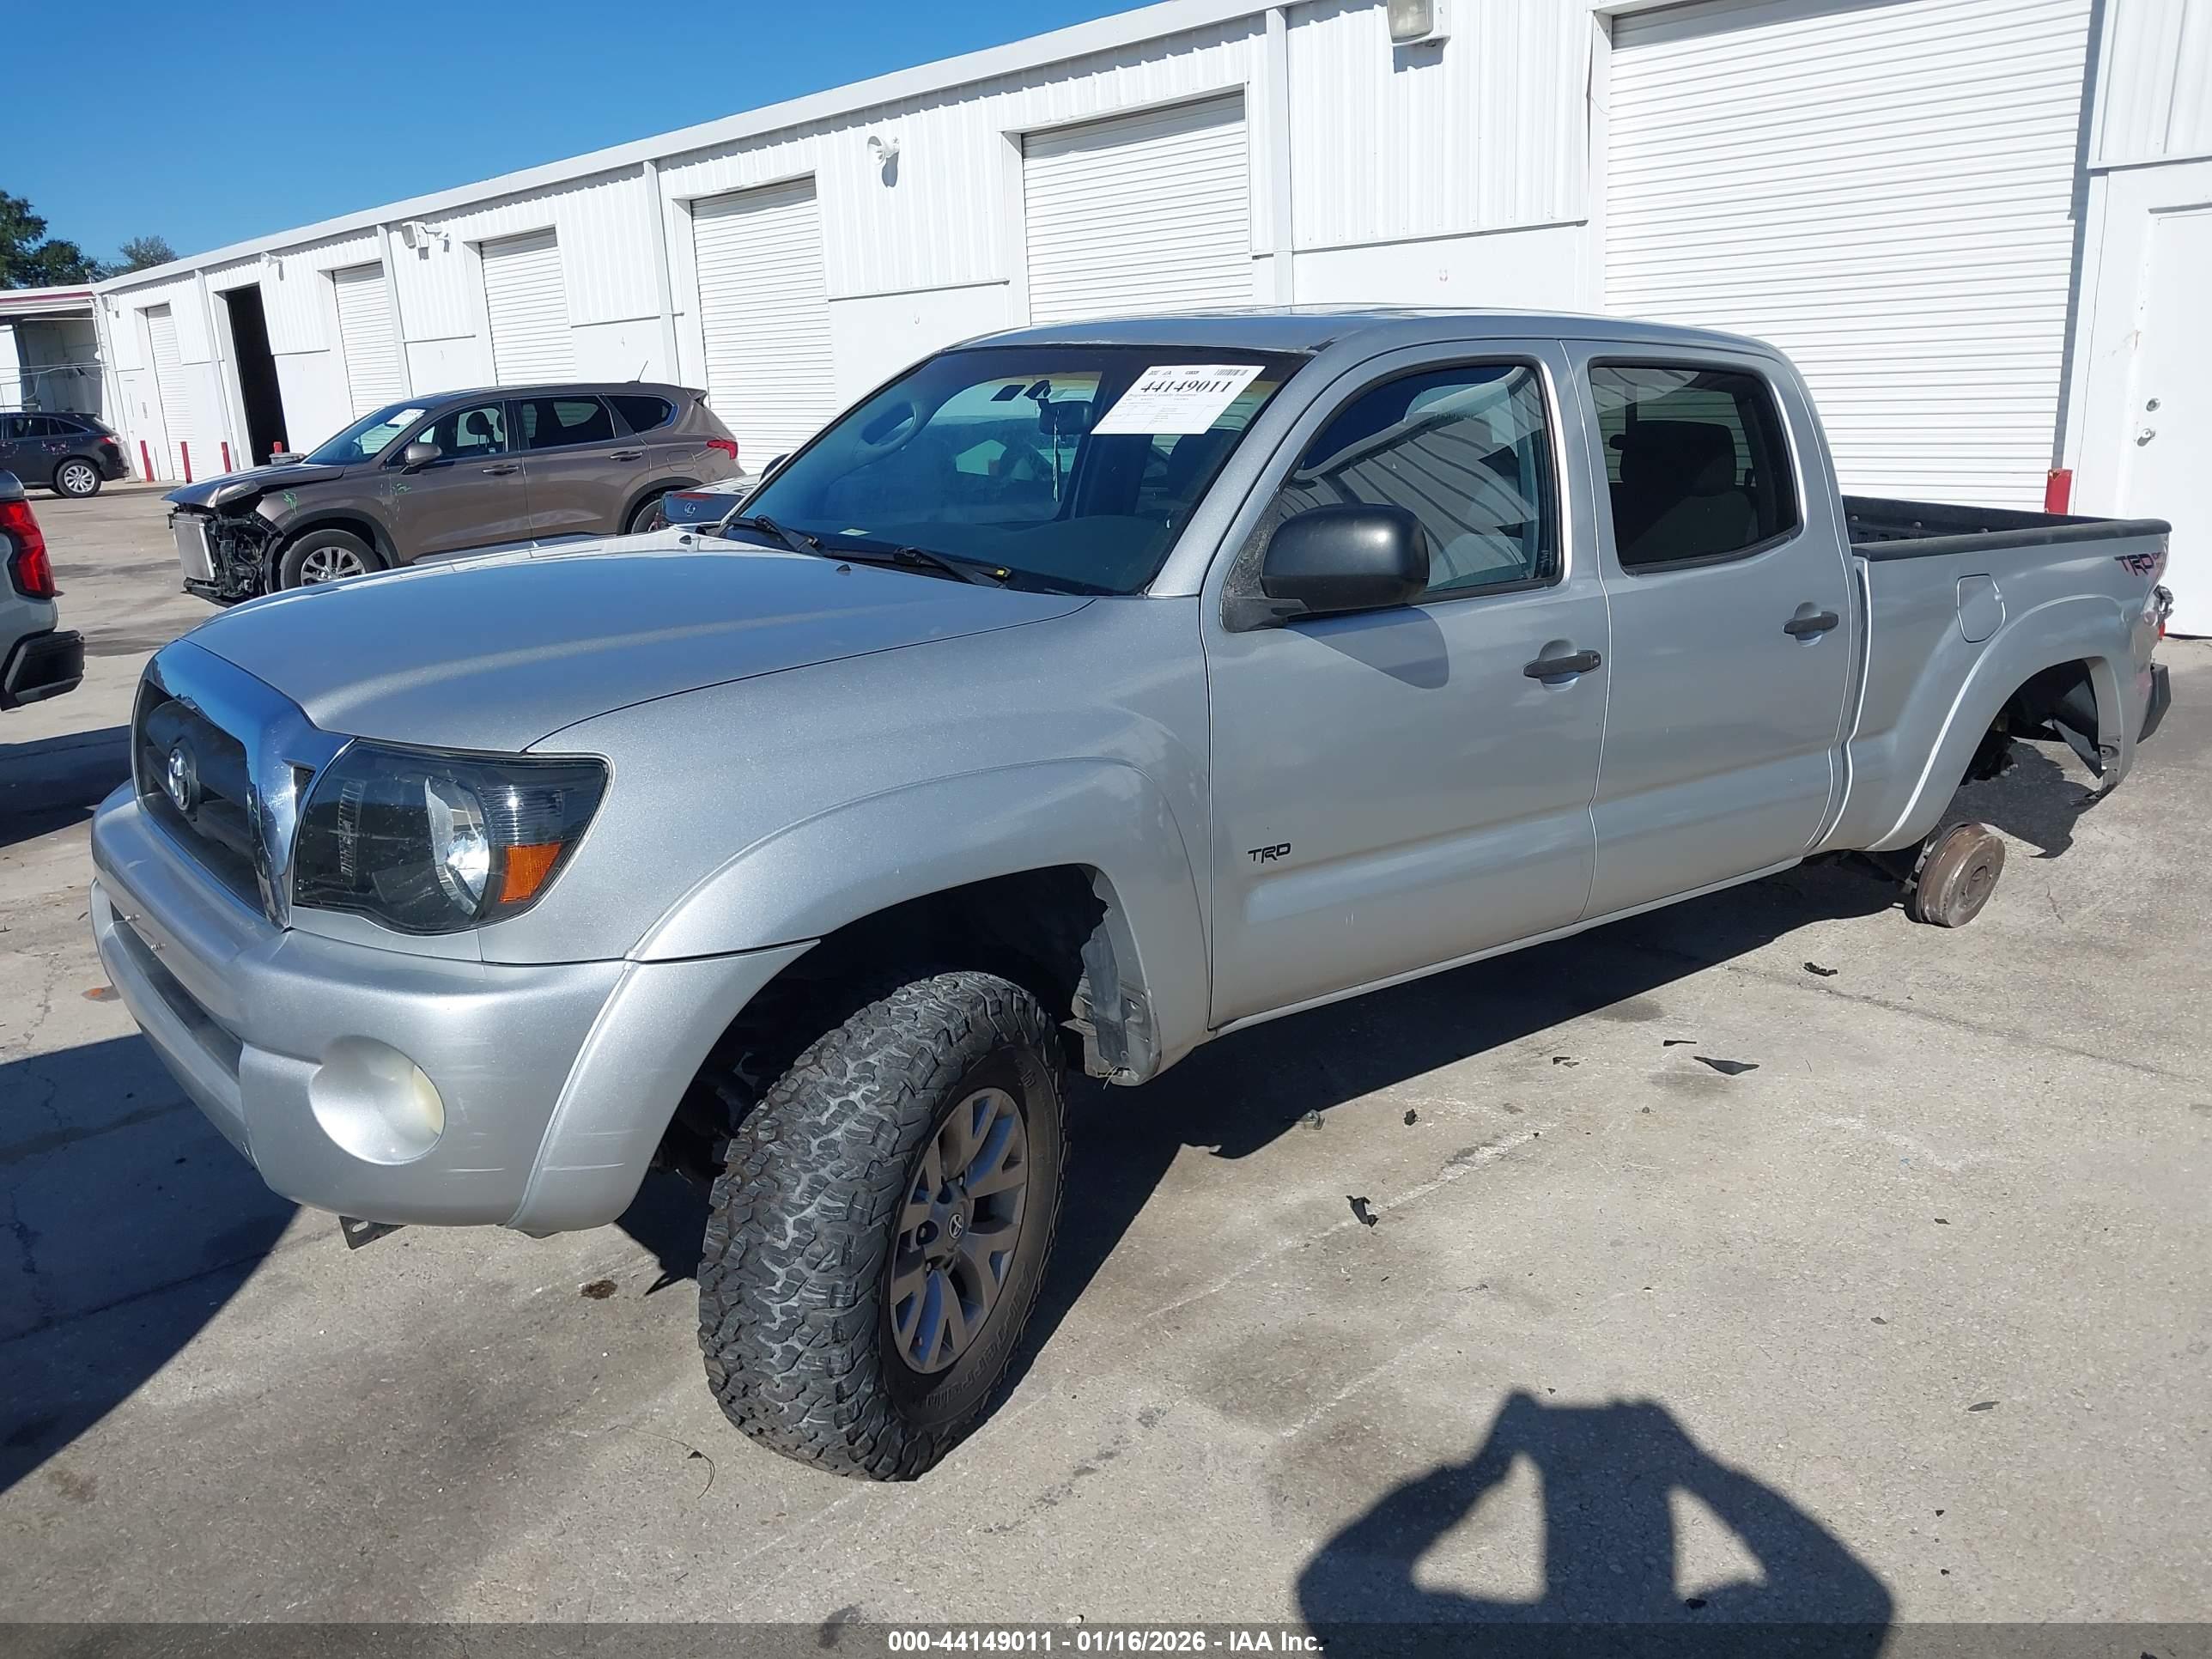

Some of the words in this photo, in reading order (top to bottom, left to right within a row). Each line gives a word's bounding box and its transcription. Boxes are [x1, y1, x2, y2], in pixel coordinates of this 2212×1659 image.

[1140, 380, 1234, 392] 44149011
[2114, 553, 2154, 576] TRD
[1248, 842, 1291, 864] TRD
